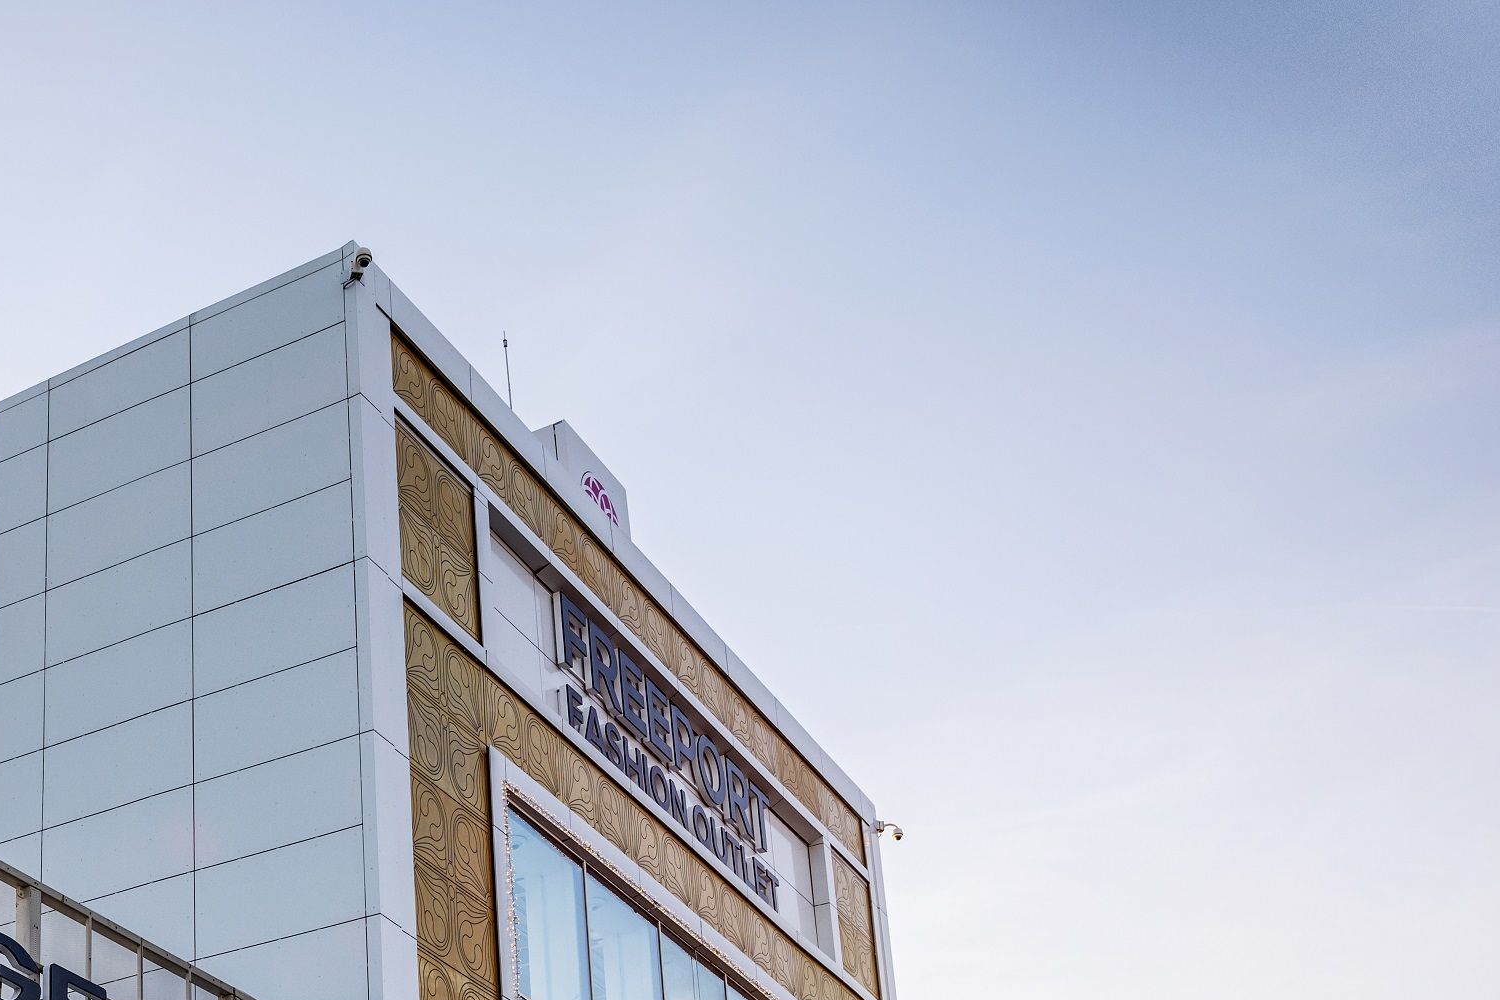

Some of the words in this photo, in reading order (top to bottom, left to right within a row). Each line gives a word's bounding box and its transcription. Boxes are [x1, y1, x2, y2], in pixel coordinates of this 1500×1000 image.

[553, 590, 769, 854] FREEPORT
[565, 684, 688, 831] FASHION
[688, 804, 779, 913] OUTLET
